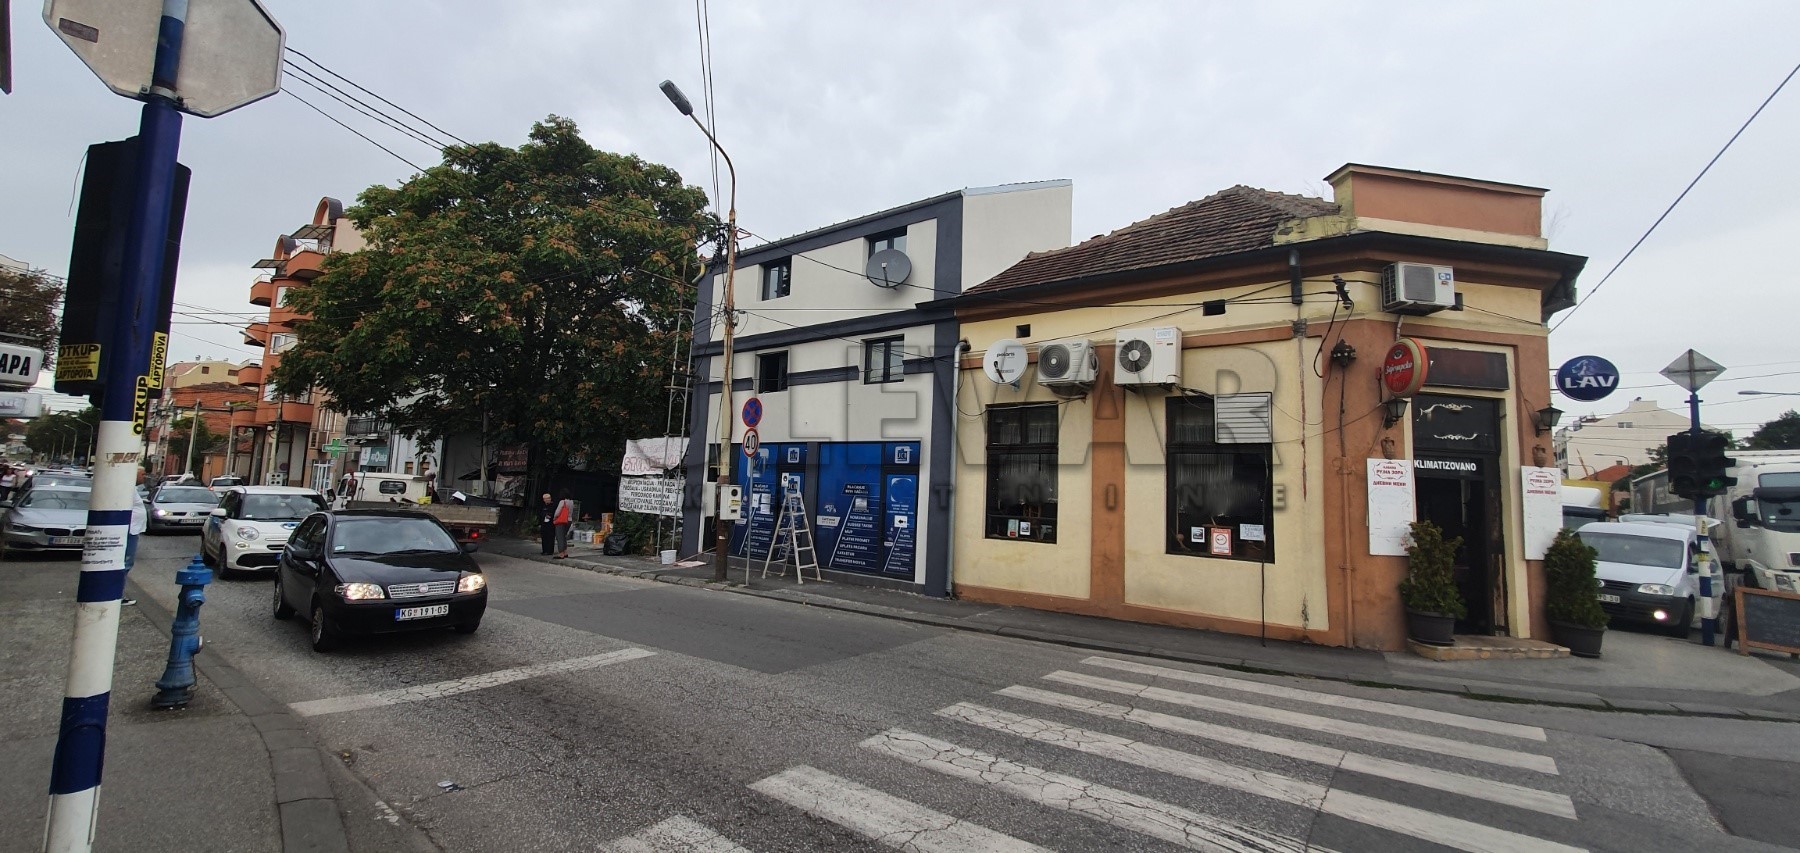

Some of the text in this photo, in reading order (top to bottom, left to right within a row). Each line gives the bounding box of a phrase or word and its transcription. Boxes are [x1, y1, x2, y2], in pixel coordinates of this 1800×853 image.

[59, 344, 100, 358] OTKUP
[152, 335, 166, 388] LAPTOPOVA
[56, 368, 94, 380] LAPTOPOVA
[1564, 374, 1615, 389] LAV
[133, 376, 148, 435] OTKUP
[745, 434, 756, 450] 40
[1414, 459, 1477, 471] KLIMATIZOVANO
[400, 605, 449, 618] KG 191-OS
